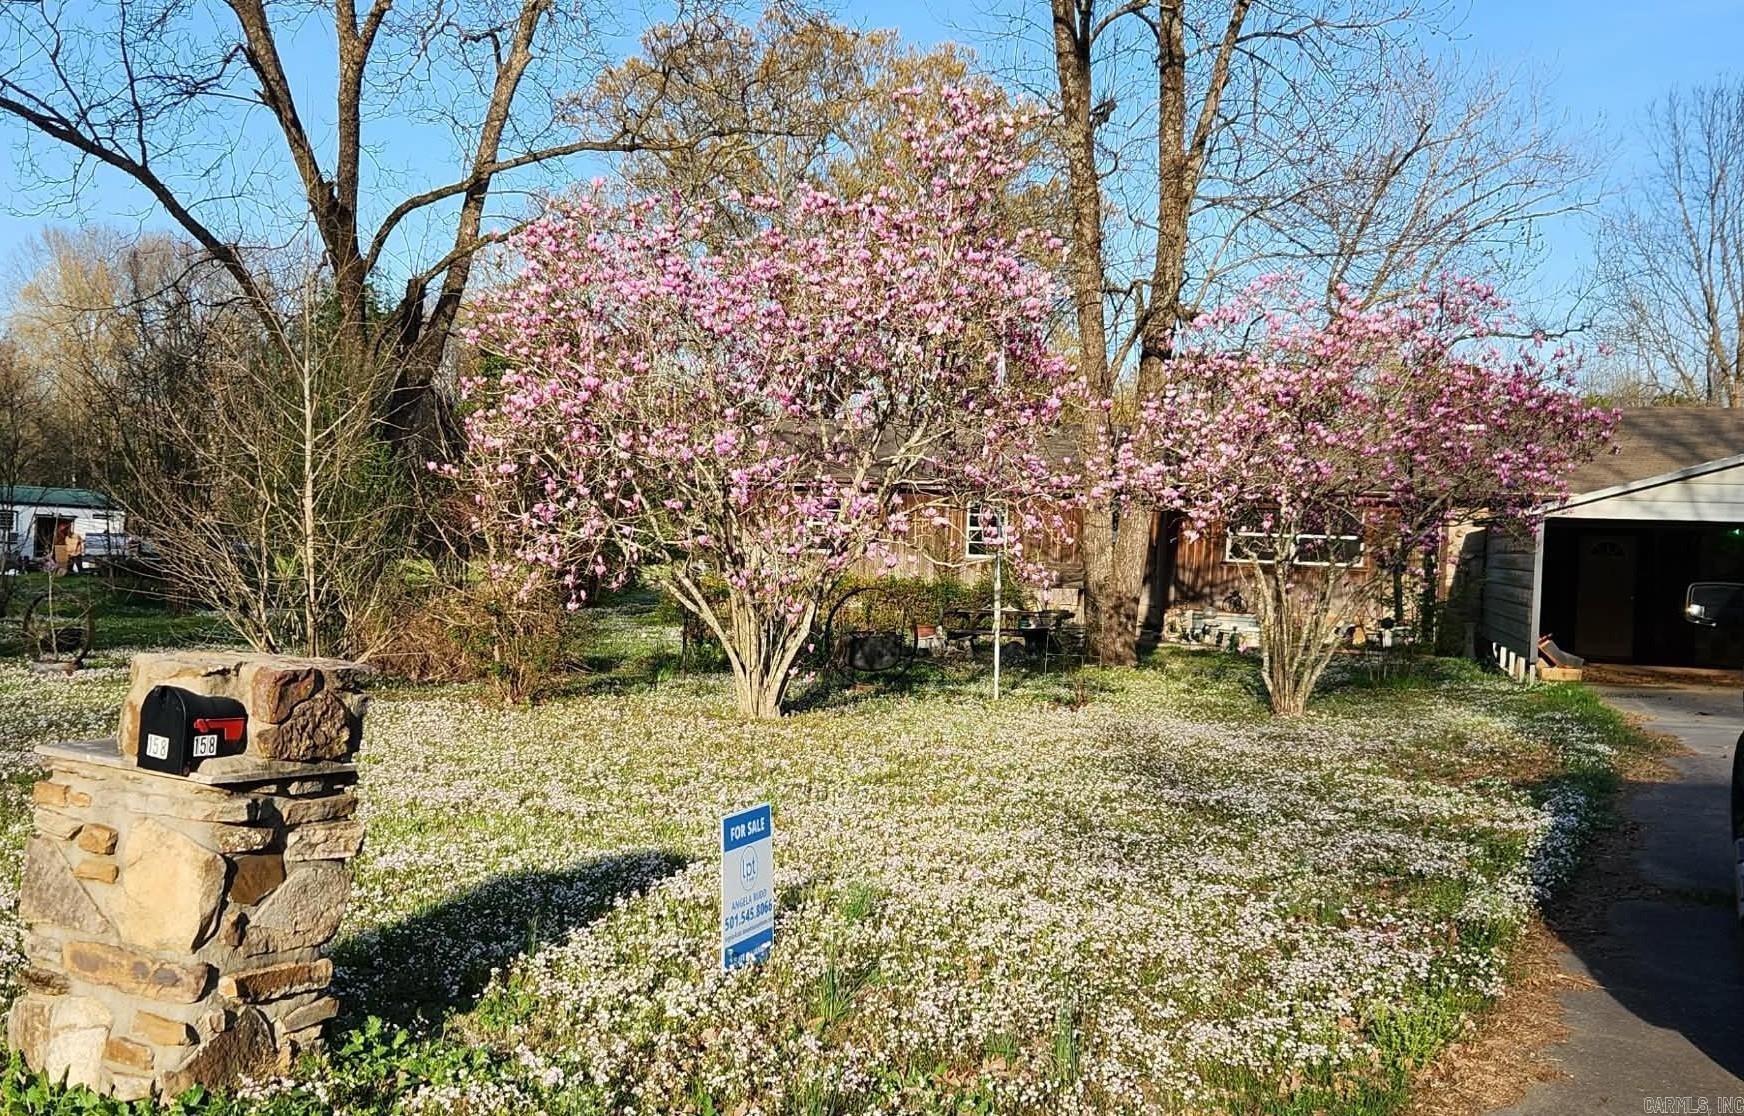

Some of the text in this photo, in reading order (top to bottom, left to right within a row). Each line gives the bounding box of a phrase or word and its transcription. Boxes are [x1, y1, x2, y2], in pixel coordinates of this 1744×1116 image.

[148, 736, 168, 757] 158
[195, 737, 216, 755] 158
[730, 816, 765, 841] FOR SALE
[731, 895, 752, 910] ANGELA
